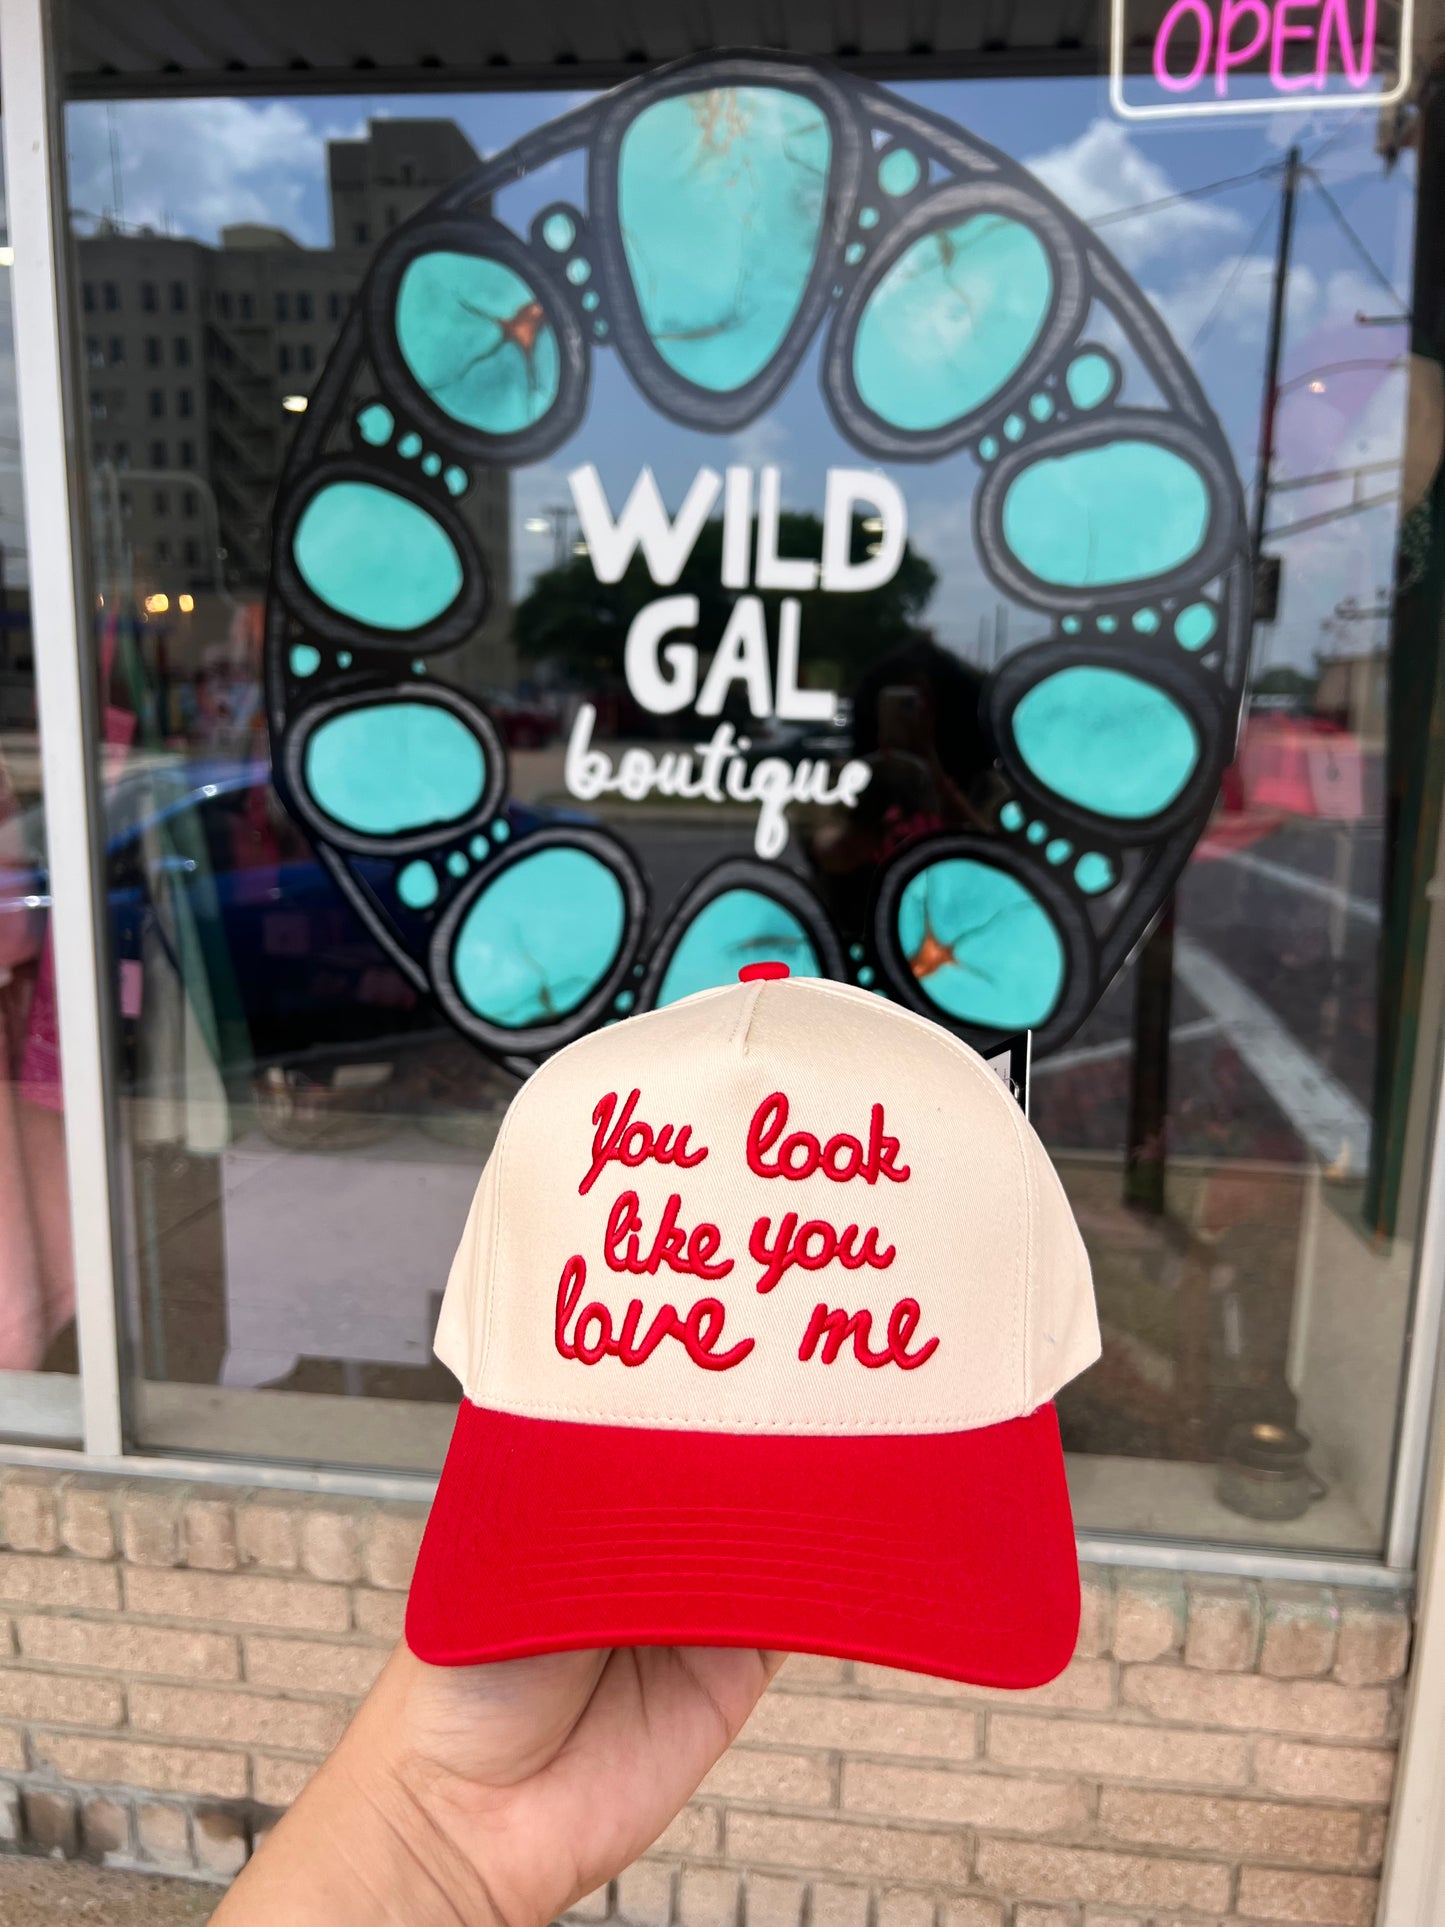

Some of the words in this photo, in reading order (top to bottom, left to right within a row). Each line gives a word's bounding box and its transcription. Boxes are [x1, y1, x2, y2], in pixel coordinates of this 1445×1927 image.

[1153, 0, 1378, 96] OPEN
[567, 462, 908, 592] WILD
[624, 594, 837, 720] GAL
[565, 702, 873, 859] boutique
[578, 1088, 709, 1196] You
[746, 1091, 911, 1185] look
[604, 1190, 735, 1280] like
[748, 1212, 896, 1295] you
[555, 1254, 756, 1372] love
[798, 1297, 940, 1371] me
